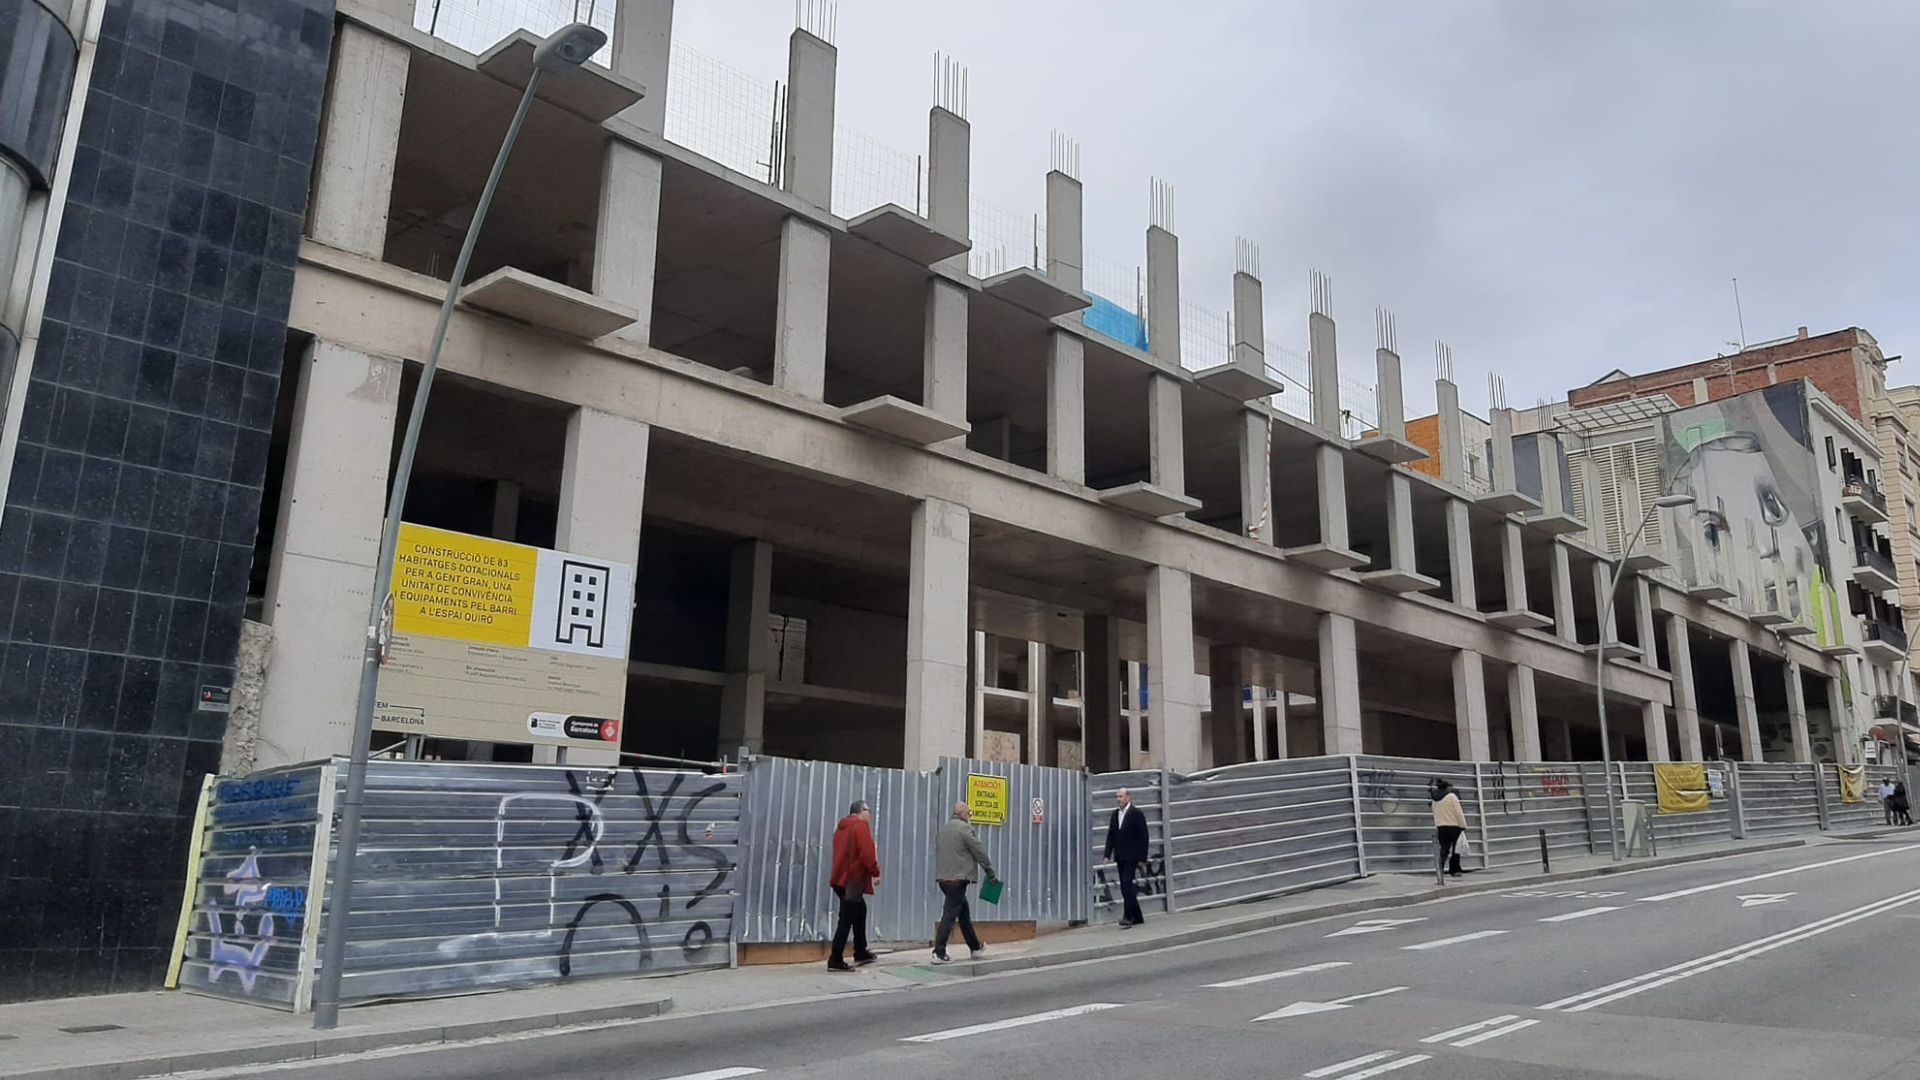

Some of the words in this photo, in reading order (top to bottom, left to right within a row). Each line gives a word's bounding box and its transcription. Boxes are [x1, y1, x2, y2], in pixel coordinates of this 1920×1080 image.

[399, 554, 457, 571] HABITATGES
[459, 564, 520, 581] DOTACIONALS
[483, 556, 495, 566] DE
[497, 558, 508, 567] 83
[401, 578, 435, 592] UNITAT
[437, 584, 449, 594] DE
[405, 567, 424, 578] PER
[426, 571, 433, 580] A
[435, 572, 460, 584] GENT
[493, 582, 512, 592] UNA
[400, 591, 468, 609] EQUIPAMENTS
[470, 601, 488, 612] PEL
[489, 604, 517, 616] BARRI
[420, 606, 427, 615] A
[429, 608, 462, 620] L'ESPAI
[381, 715, 425, 726] BARCELONA
[1500, 891, 1626, 899] BUS
